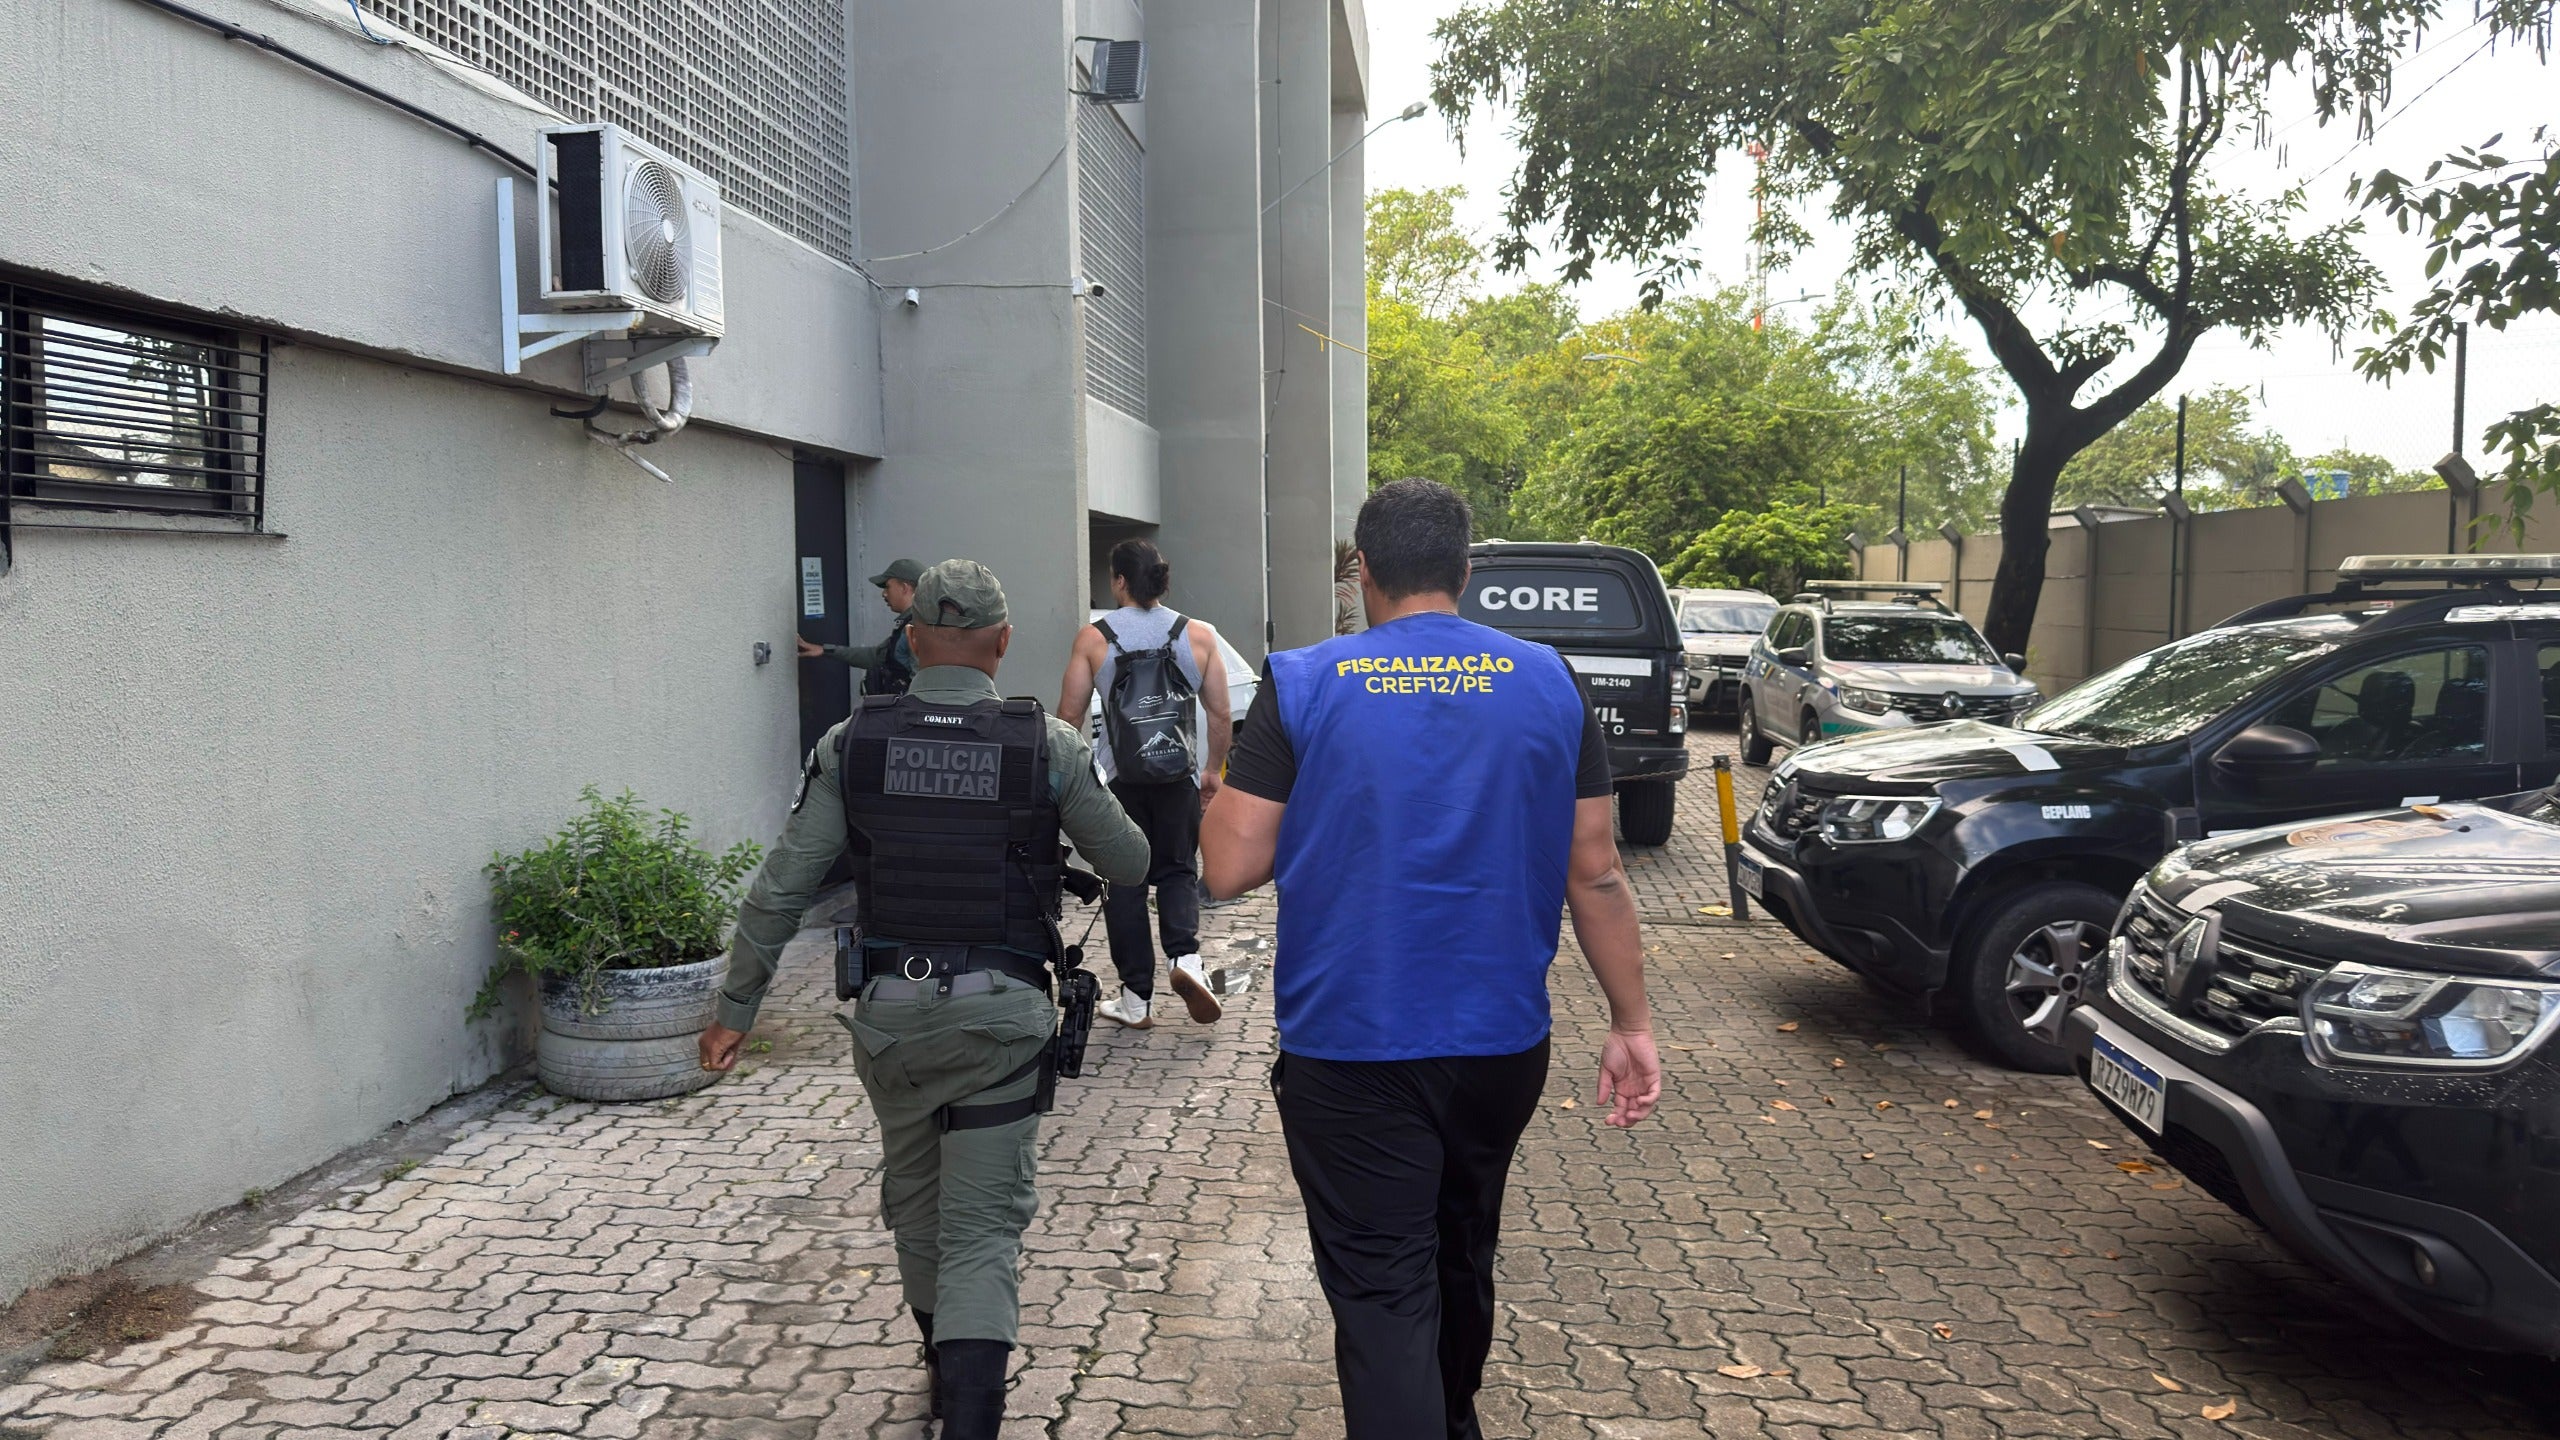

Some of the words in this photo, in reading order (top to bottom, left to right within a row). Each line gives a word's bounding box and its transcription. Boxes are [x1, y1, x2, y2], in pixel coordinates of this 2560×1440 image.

[1479, 586, 1599, 612] CORE
[1336, 653, 1515, 677] FISCALIZAÇÃO
[1365, 675, 1494, 696] CREF12/PE
[1591, 677, 1631, 688] UM-2140
[889, 744, 996, 773] POLÍCIA
[1140, 747, 1180, 758] WATERLAND
[887, 769, 994, 797] MILITAR
[2097, 1055, 2156, 1120] RZZ9H79
